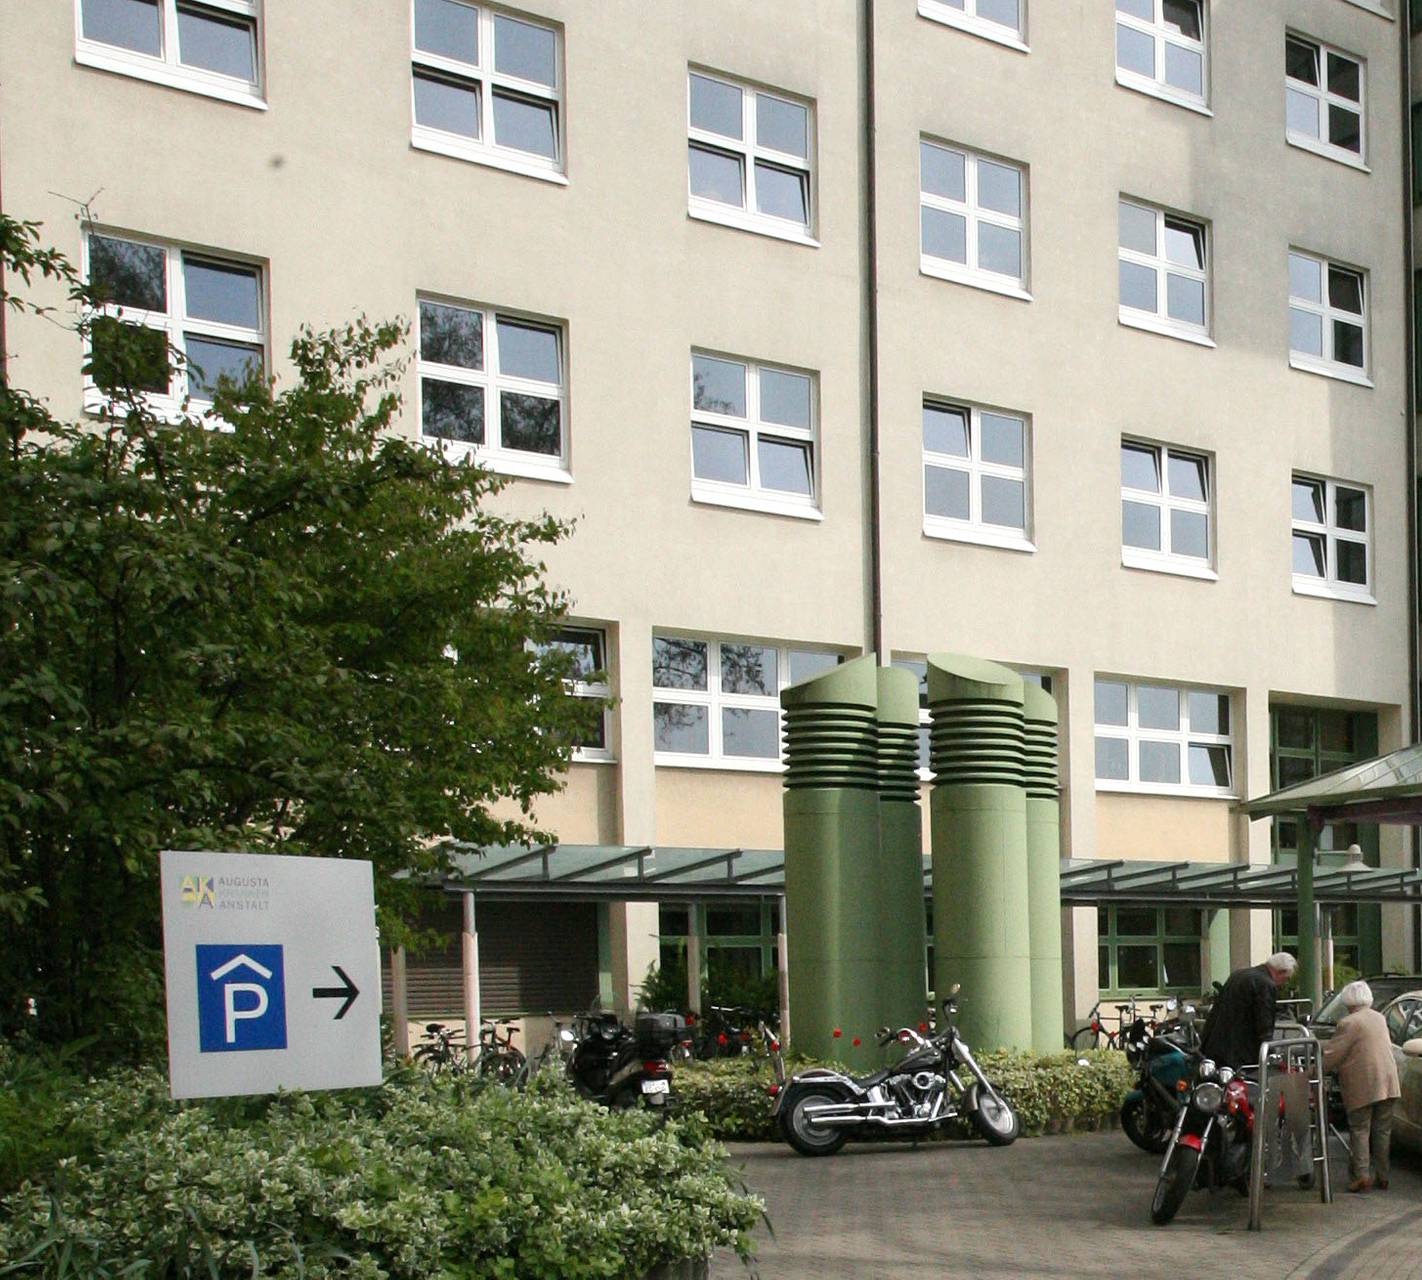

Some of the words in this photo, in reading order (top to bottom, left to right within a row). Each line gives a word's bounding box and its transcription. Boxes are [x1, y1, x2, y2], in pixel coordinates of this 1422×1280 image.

[218, 877, 270, 887] AUGUSTA
[219, 900, 270, 911] ANSTALT
[224, 982, 269, 1043] P
